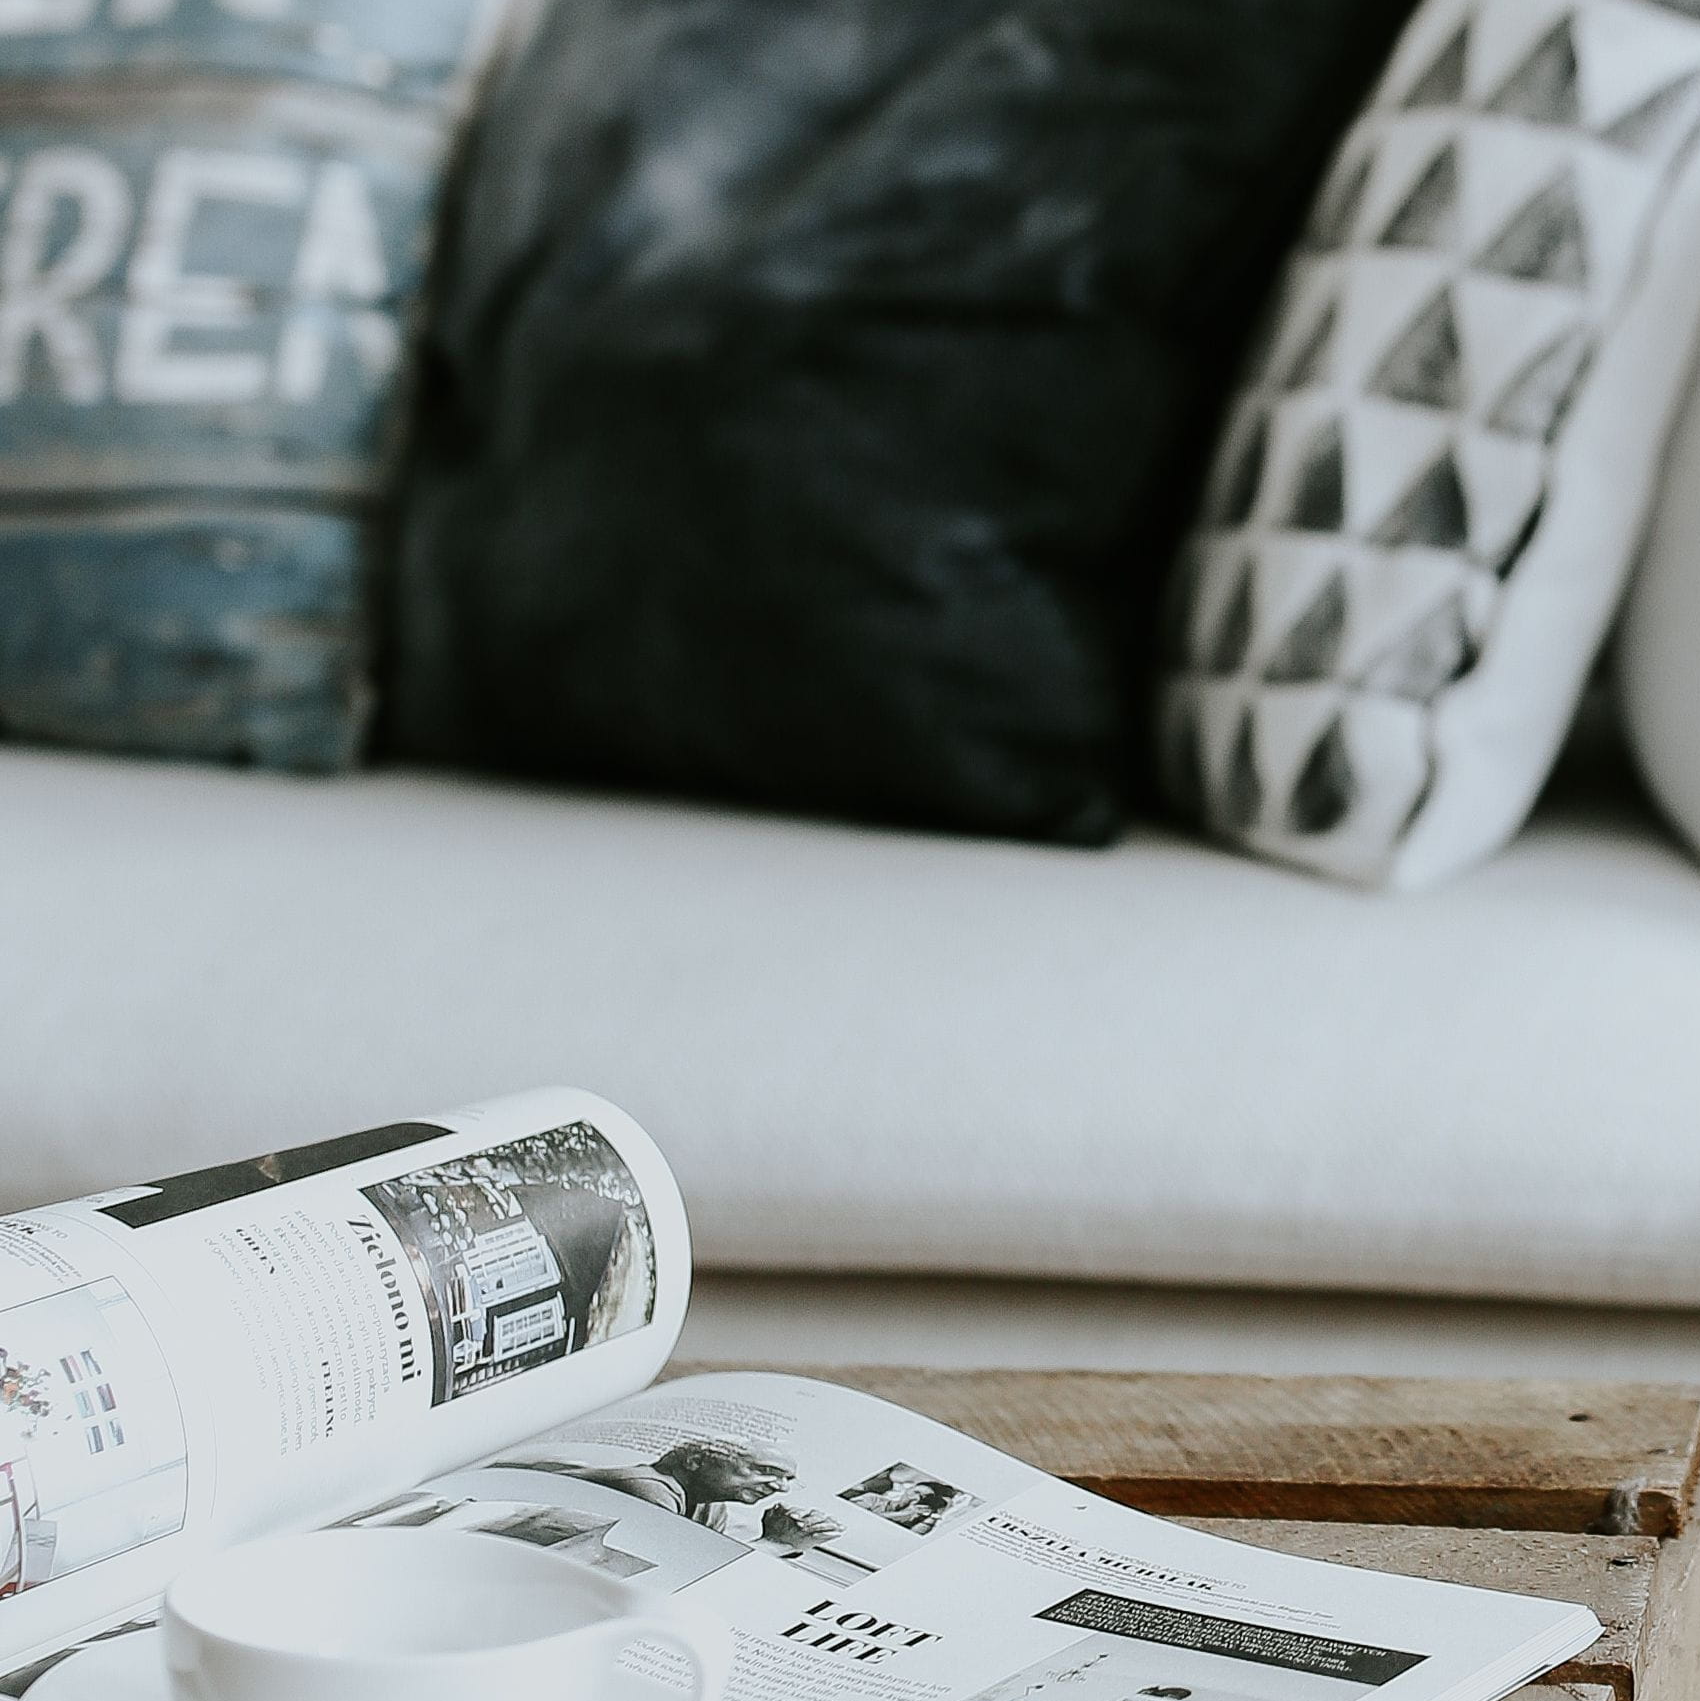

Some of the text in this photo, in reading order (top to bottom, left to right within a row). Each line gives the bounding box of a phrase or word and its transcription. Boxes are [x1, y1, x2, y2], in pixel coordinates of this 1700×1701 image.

[346, 1212, 422, 1384] Zielono mi
[364, 1344, 375, 1365] ich
[320, 1360, 335, 1438] FEELING
[366, 1366, 378, 1421] pokrycie
[776, 1621, 899, 1665] LIFE
[801, 1599, 944, 1647] LOFT
